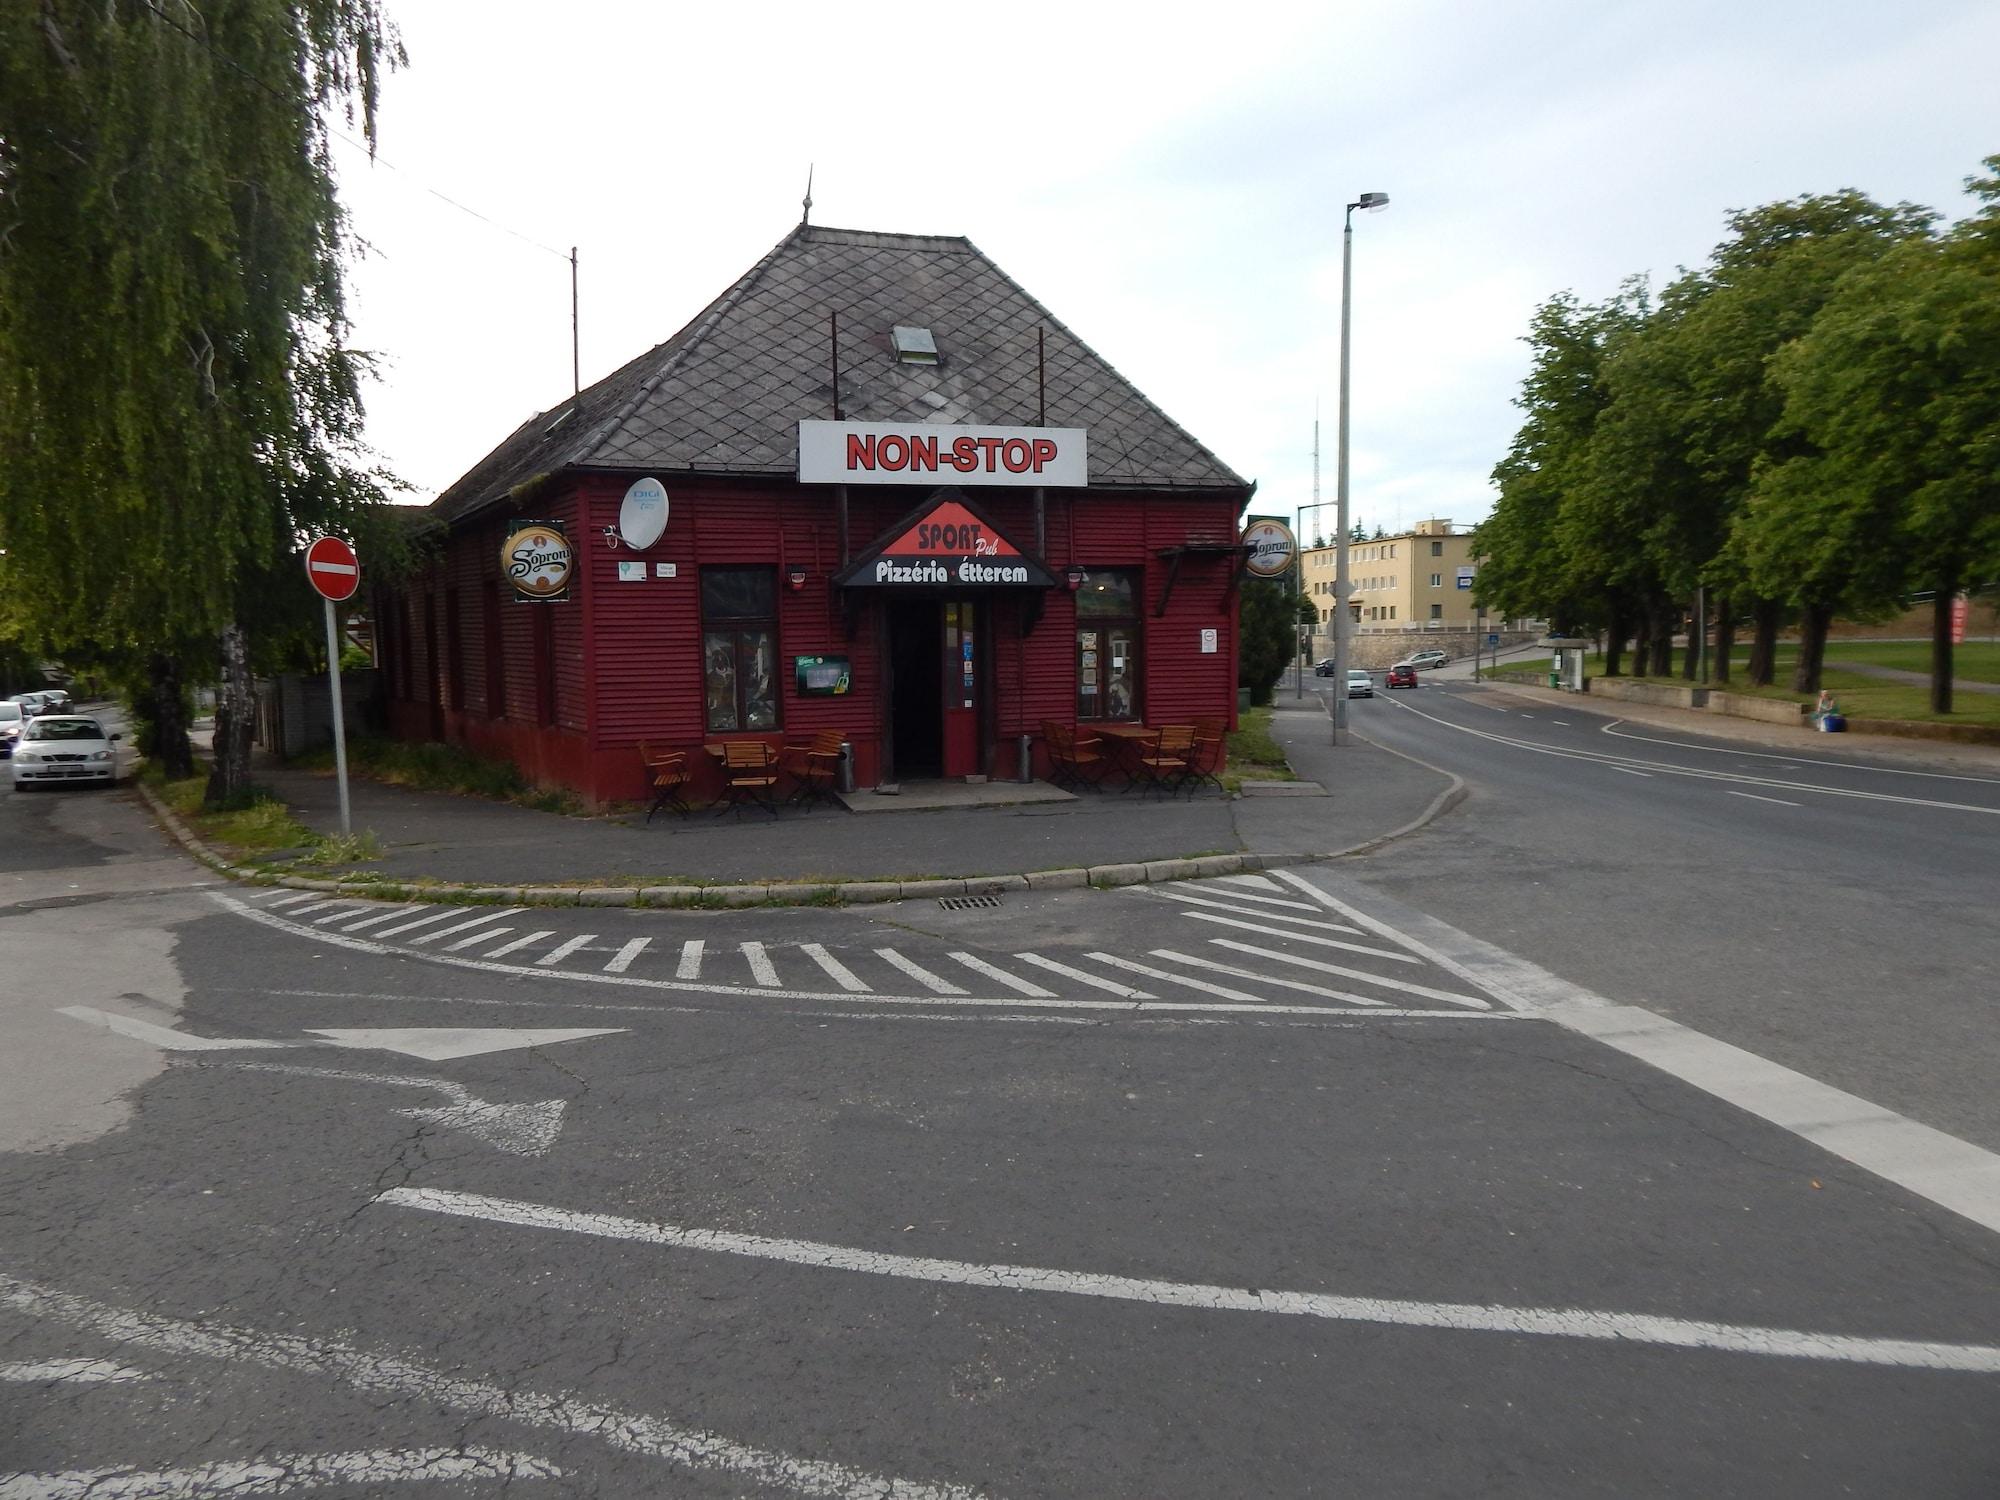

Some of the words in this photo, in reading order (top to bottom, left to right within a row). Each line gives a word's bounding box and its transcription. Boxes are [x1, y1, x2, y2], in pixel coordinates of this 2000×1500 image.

[846, 434, 1058, 474] NON-STOP
[918, 524, 981, 549] SPORT
[974, 536, 1000, 557] Pub
[509, 548, 570, 577] Soproni
[875, 559, 948, 583] Pizzéria
[958, 556, 1028, 583] Étterem
